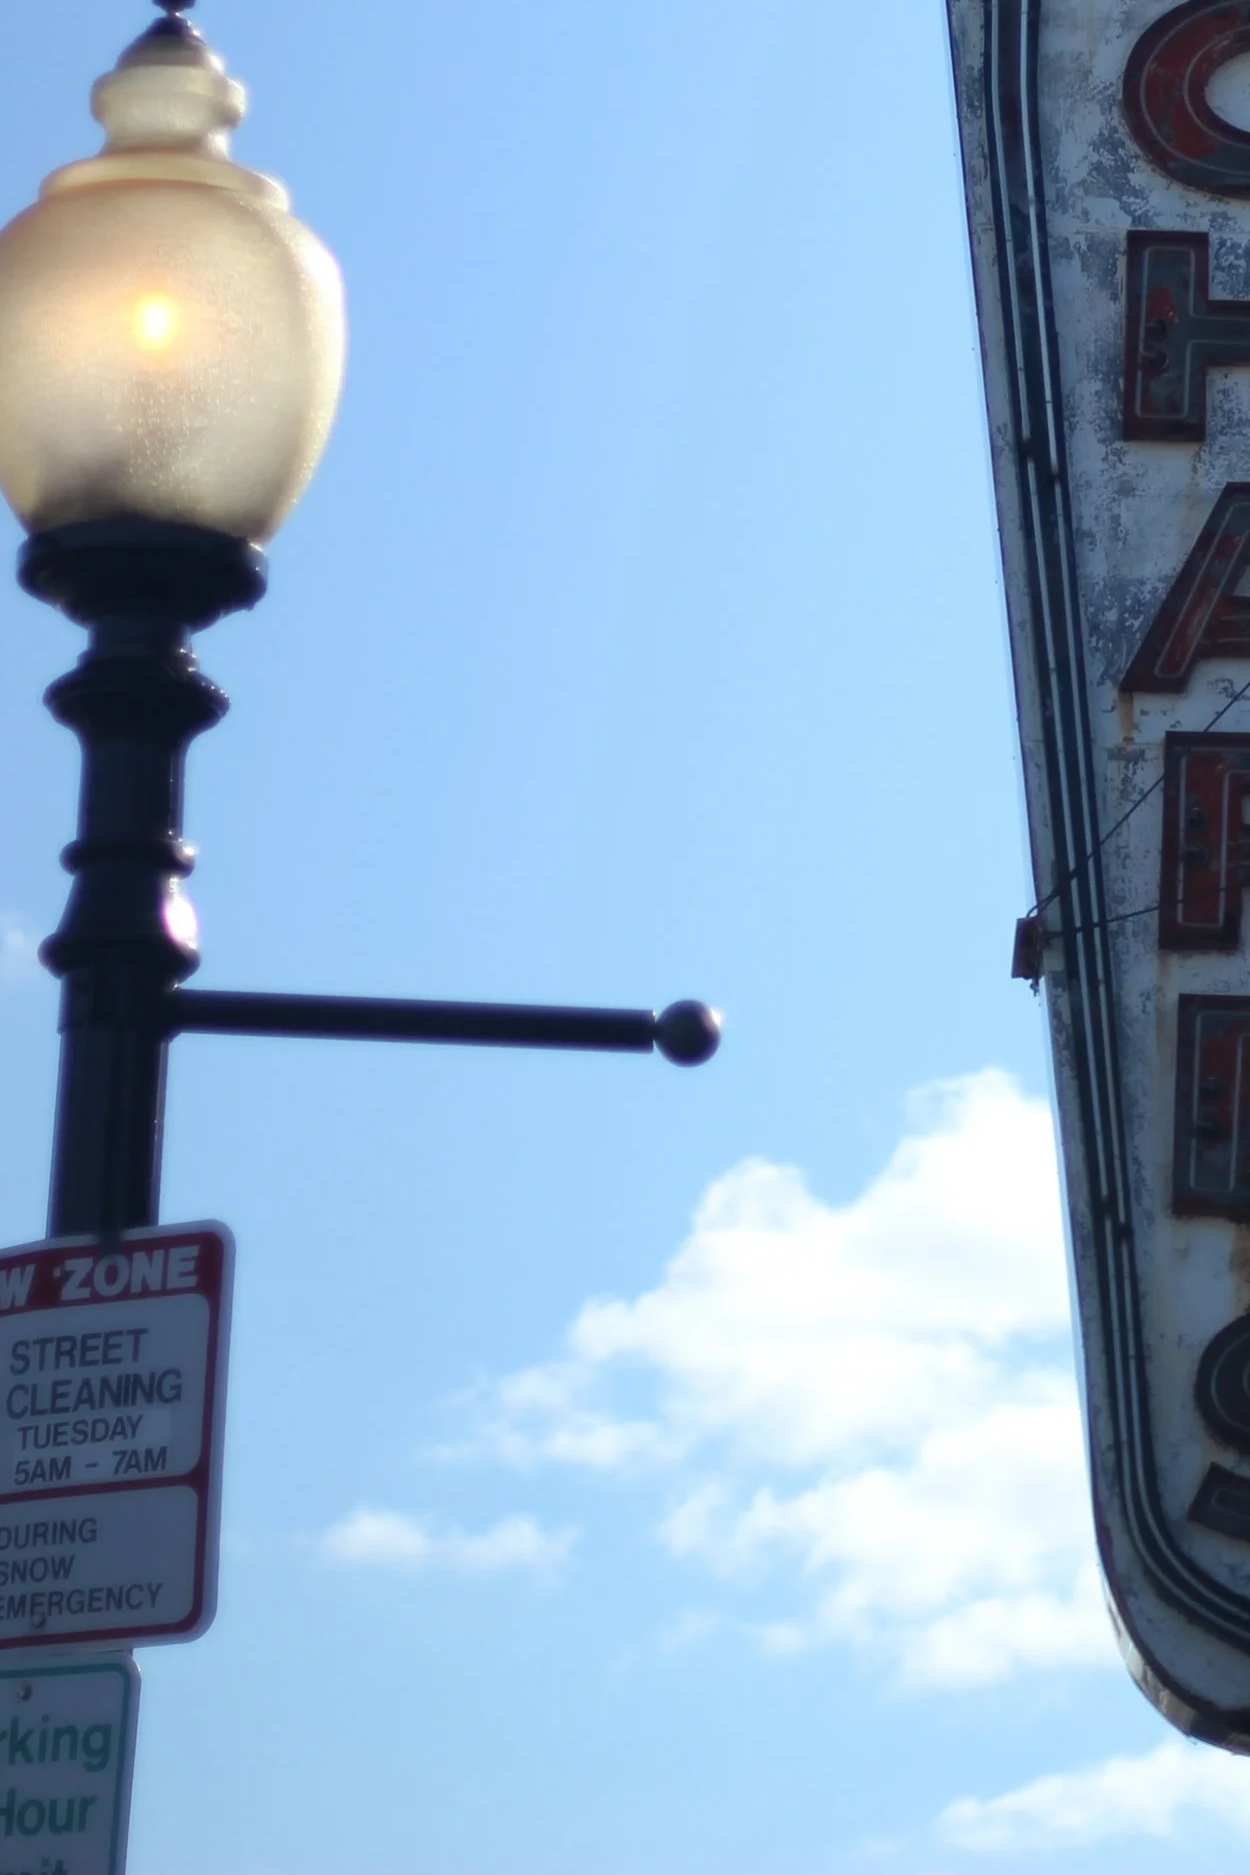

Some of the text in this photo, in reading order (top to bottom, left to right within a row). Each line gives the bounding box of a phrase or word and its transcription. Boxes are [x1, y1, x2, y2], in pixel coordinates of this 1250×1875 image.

[60, 1245, 199, 1302] ZONE
[9, 1327, 149, 1376] STREET
[6, 1368, 183, 1420] CLEANING
[17, 1414, 144, 1451] TUESDAY
[13, 1455, 72, 1486] 5AM
[111, 1445, 168, 1476] 7AM
